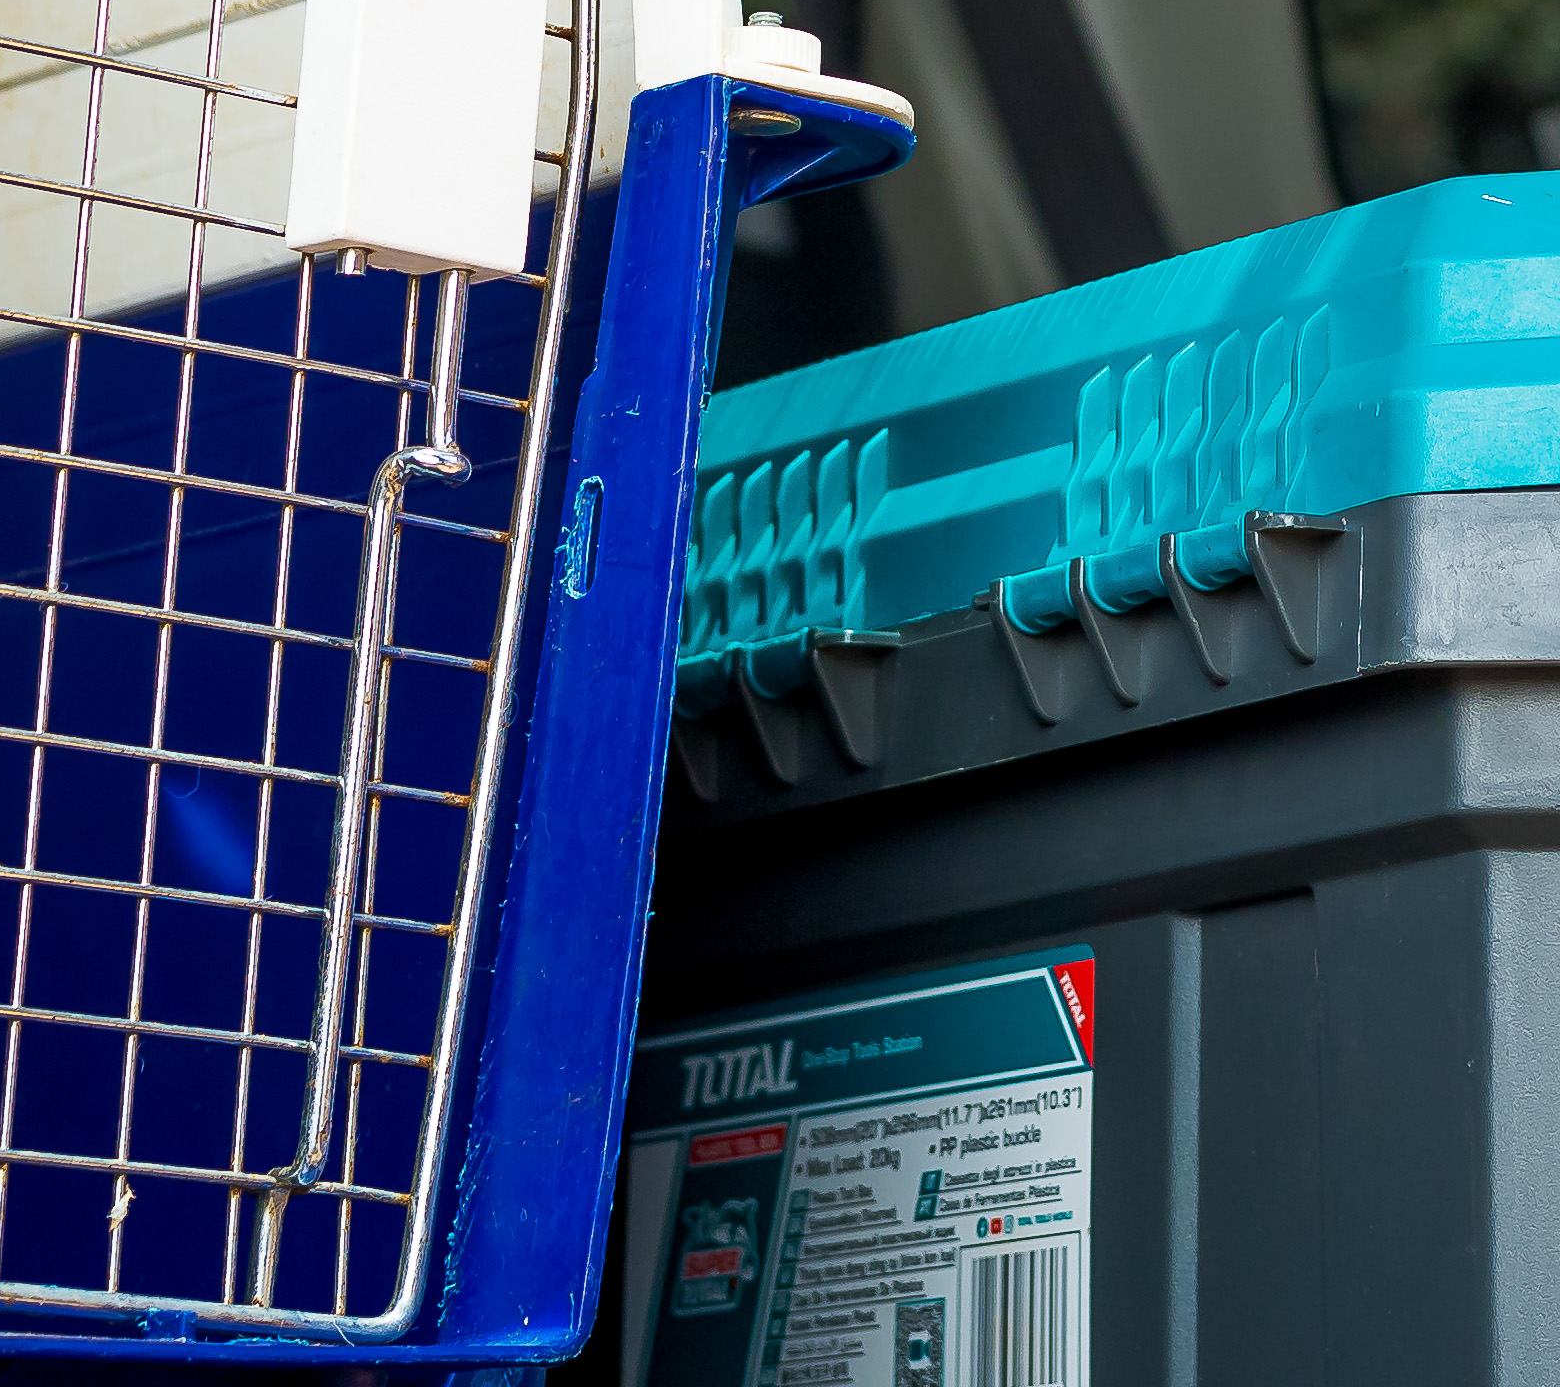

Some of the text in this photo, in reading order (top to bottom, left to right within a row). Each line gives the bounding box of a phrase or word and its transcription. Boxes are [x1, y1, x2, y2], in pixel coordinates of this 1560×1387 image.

[1059, 969, 1086, 1028] TOTAL
[683, 1038, 797, 1109] TOTAL
[960, 1133, 1000, 1159] plastic
[1003, 1125, 1042, 1148] buckle
